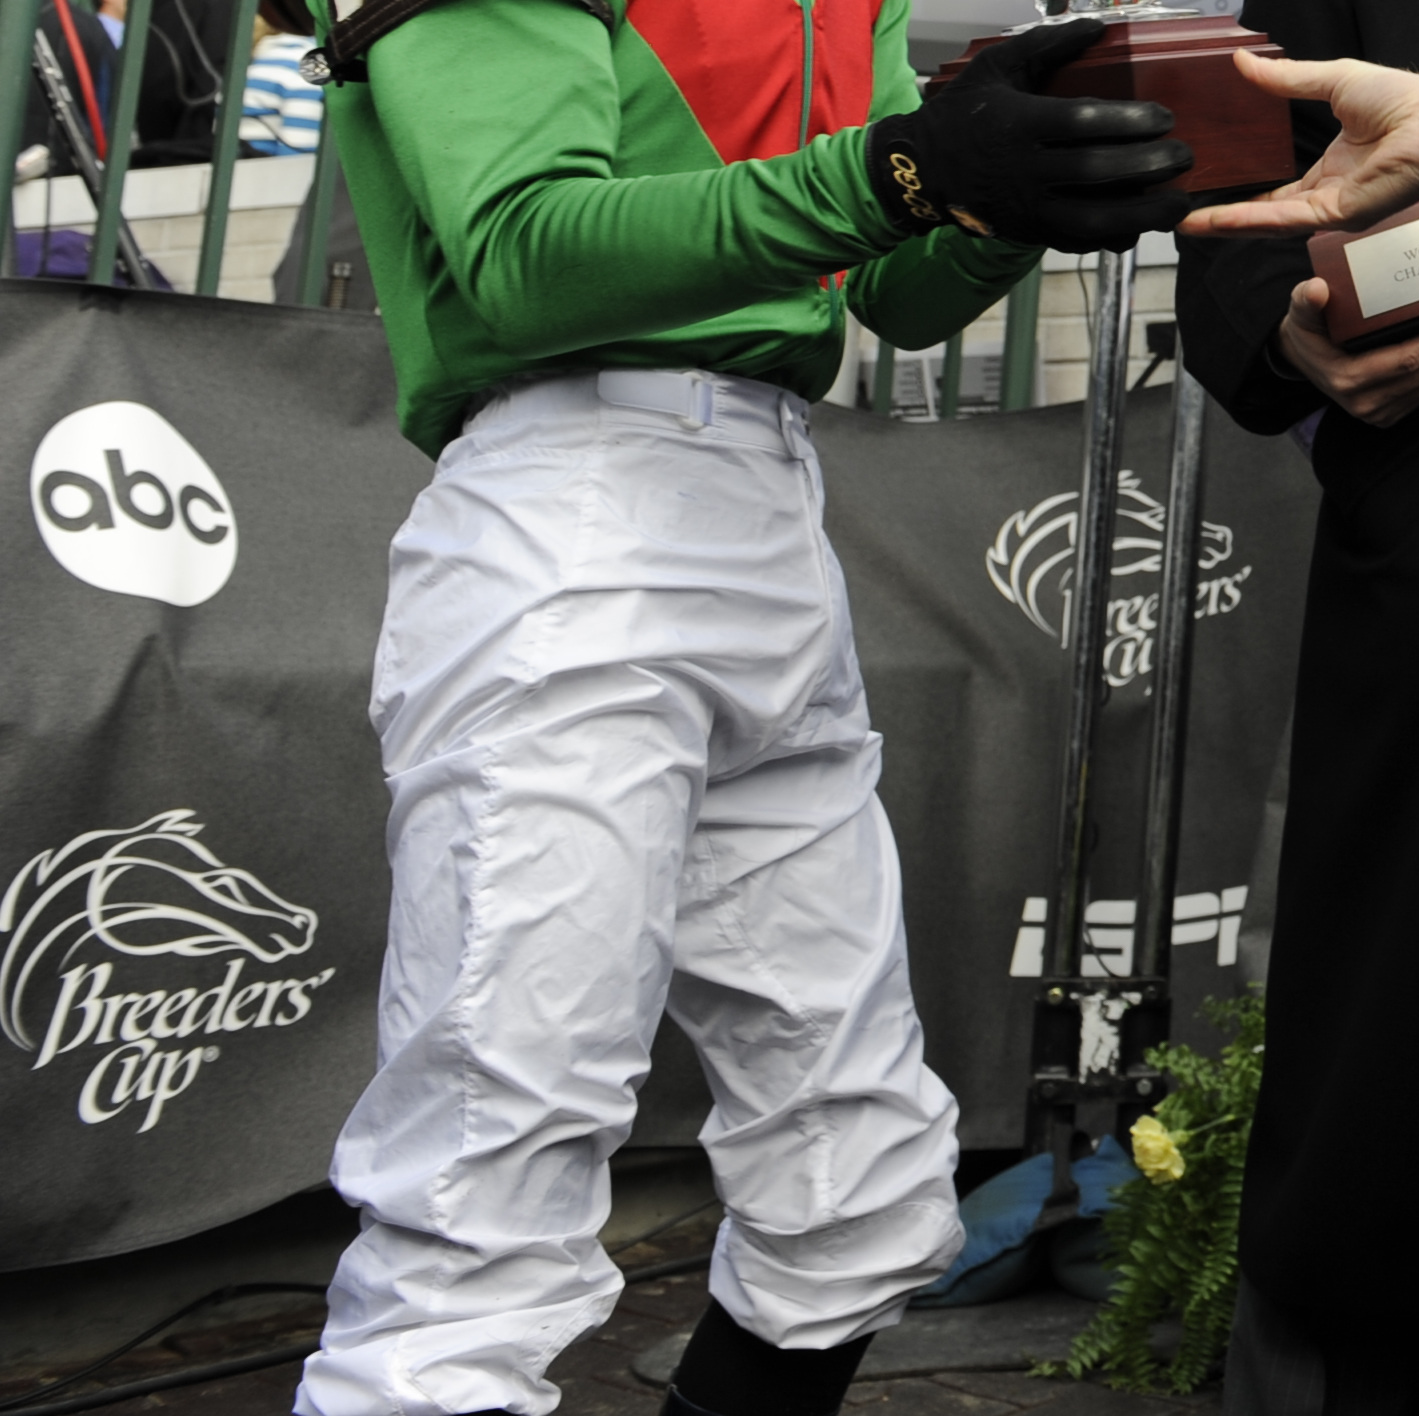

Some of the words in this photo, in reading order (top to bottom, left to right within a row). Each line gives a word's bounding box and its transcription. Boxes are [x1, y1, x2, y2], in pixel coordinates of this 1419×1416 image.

[39, 449, 229, 545] abc
[1103, 629, 1153, 696] Cu
[30, 957, 336, 1071] Breeders'
